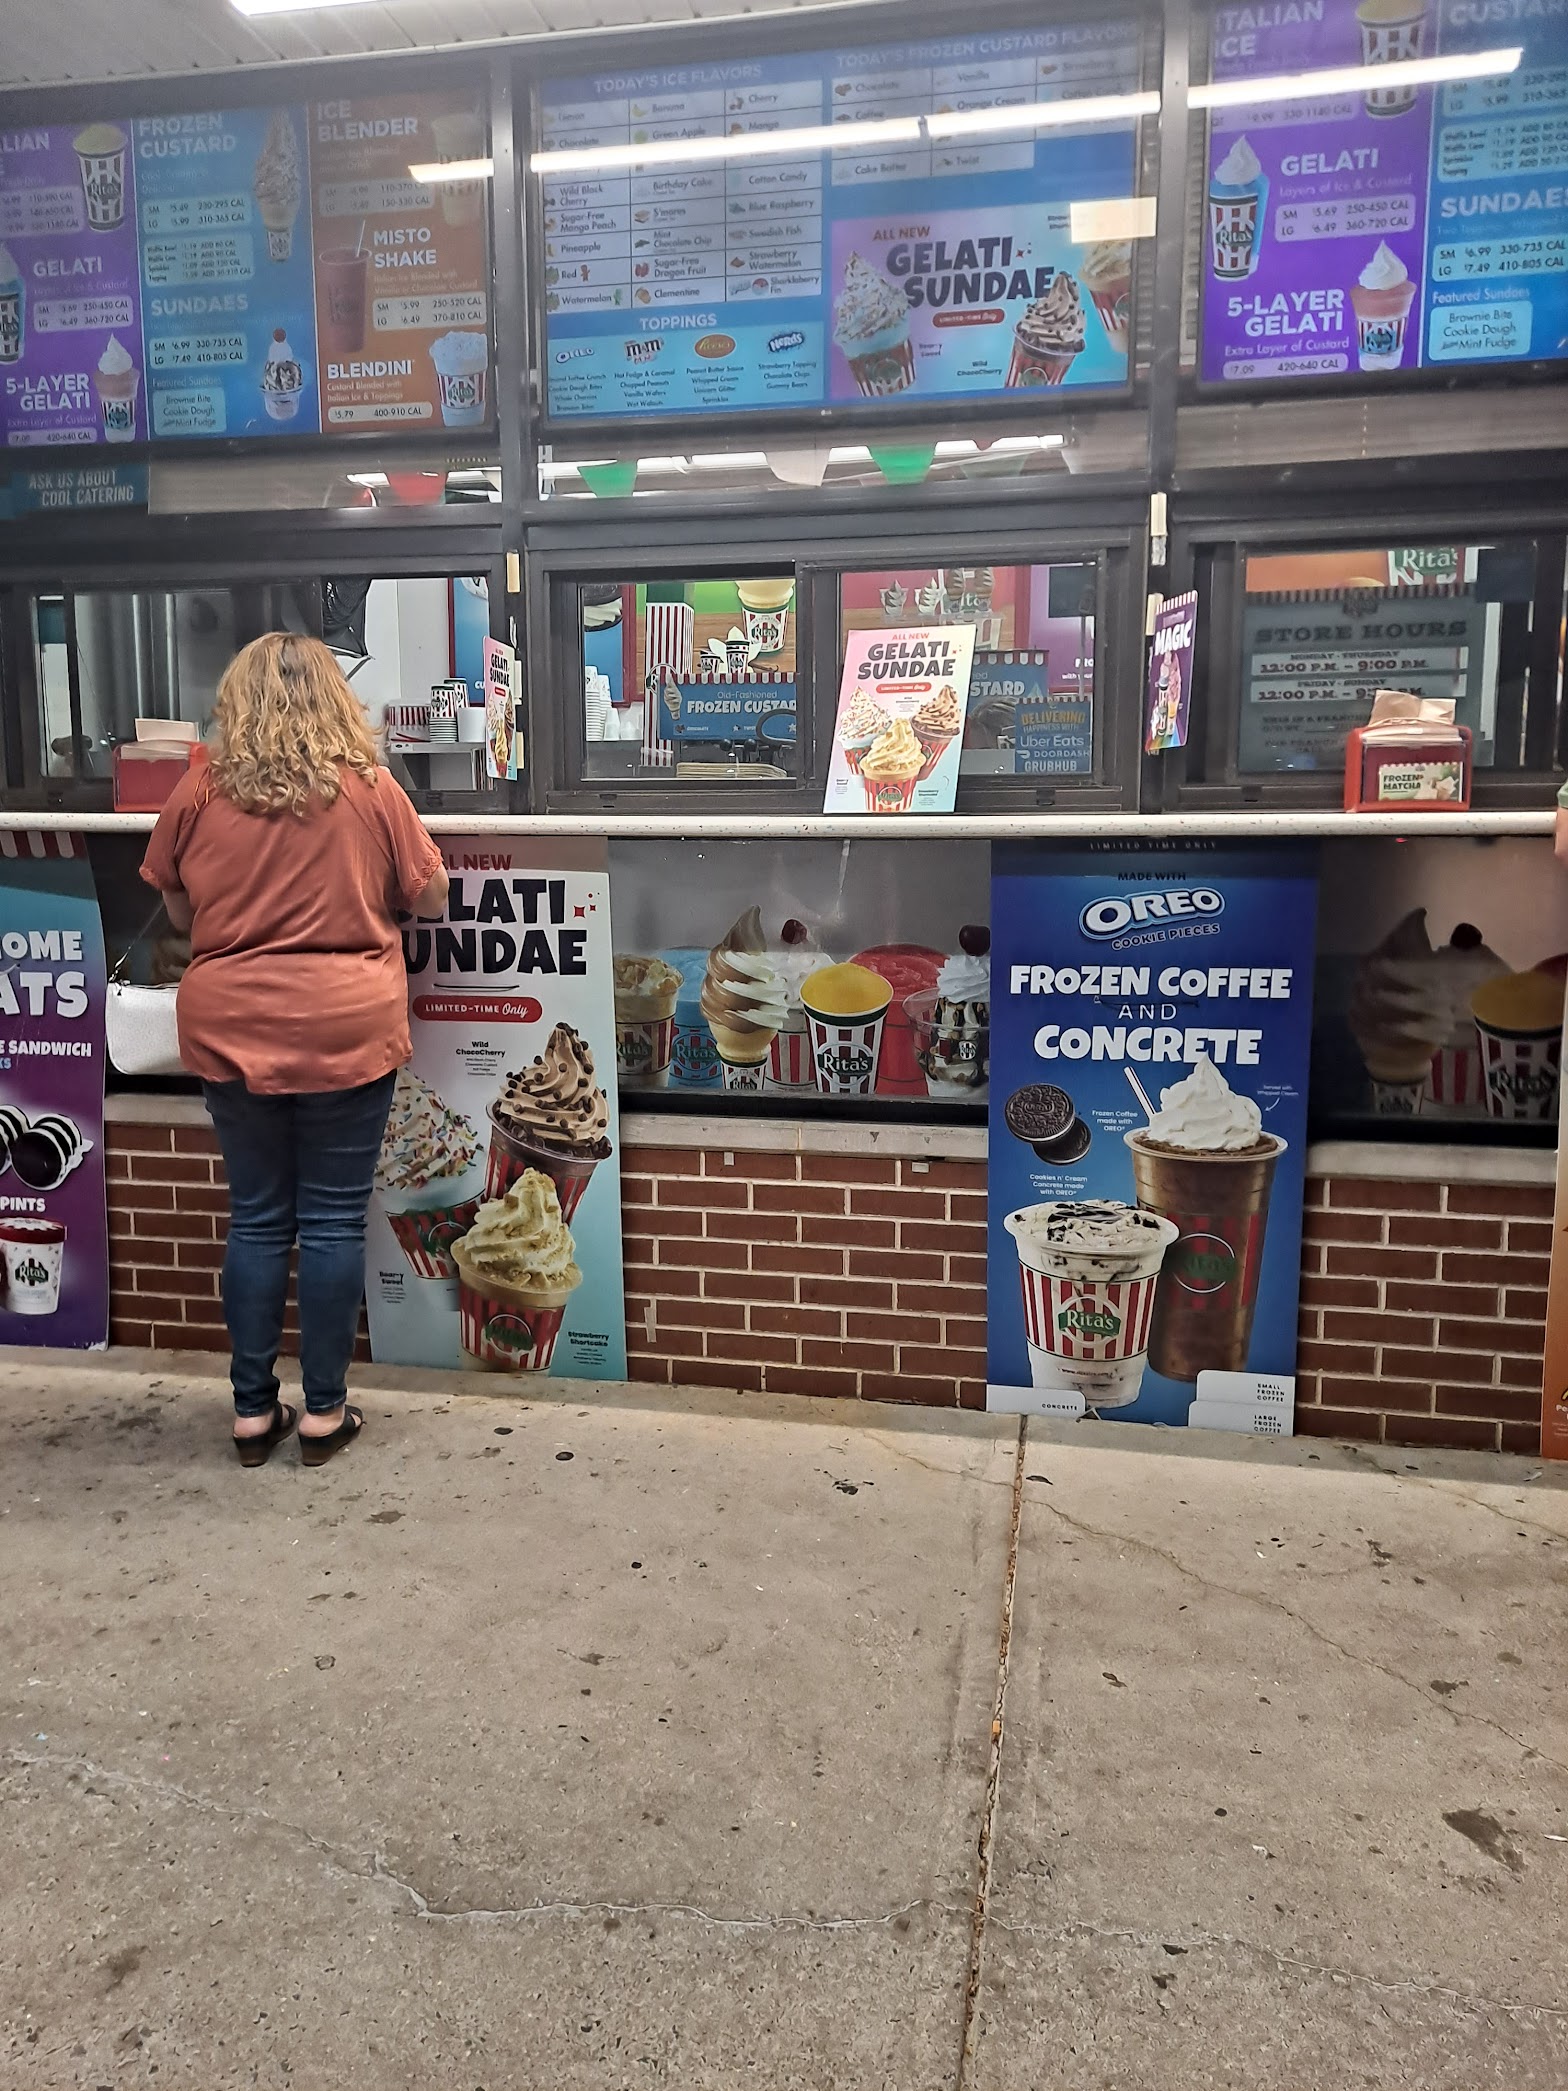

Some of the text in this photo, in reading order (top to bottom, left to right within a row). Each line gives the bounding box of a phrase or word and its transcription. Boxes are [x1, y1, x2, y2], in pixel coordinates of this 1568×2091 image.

[980, 34, 1056, 52] CUSTARD
[1215, 35, 1256, 58] ICE
[663, 72, 688, 84] ICE
[691, 65, 762, 82] FLAVORS
[749, 93, 778, 104] Cherry
[318, 102, 351, 120] ICE
[139, 113, 222, 136] FROZEN
[318, 118, 418, 141] BLENDER
[652, 130, 678, 140] Green
[140, 135, 235, 158] CUSTARD
[1281, 148, 1379, 176] GELATI
[1440, 187, 1568, 218] SUNDAE
[374, 227, 431, 246] MISTO
[872, 226, 930, 242] ALL NEW
[561, 242, 601, 255] Pineapple
[886, 237, 1013, 277] GELATI
[1440, 250, 1455, 259] SM
[33, 256, 103, 277] GELATI
[375, 249, 437, 268] SHAKE
[1439, 267, 1451, 276] LG
[1544, 258, 1563, 267] CAL
[562, 270, 577, 279] Red
[904, 267, 1054, 308] SUNDAE
[1432, 289, 1481, 303] Featured
[151, 294, 248, 316] SUNDAES
[1227, 288, 1345, 317] 5-LAYER
[640, 313, 717, 331] TOPPINGS
[1245, 311, 1343, 337] GELATI
[1449, 313, 1490, 322] Brownie
[1444, 322, 1516, 337] Cookie Dough
[1291, 339, 1303, 351] of
[328, 360, 412, 379] BLENDINI
[6, 373, 89, 394] 5-LAYER
[21, 392, 91, 411] GELATI
[29, 470, 116, 489] ASK US ABOUT
[42, 485, 134, 506] COOL CATERING
[1155, 619, 1192, 656] MAGIC
[1255, 621, 1467, 643] STORE HOURS
[868, 641, 950, 661] GELATI
[1291, 652, 1334, 660] MONDAY
[491, 653, 508, 672] GELATI
[858, 659, 956, 679] SUNDAE
[1261, 664, 1306, 673] 12:00
[1358, 660, 1396, 670] 9:00
[490, 667, 509, 687] SUNDAE
[1259, 690, 1304, 700] 12:00
[687, 701, 740, 713] FROZEN
[1021, 736, 1084, 747] Uber Eats
[1034, 750, 1091, 758] DOORDASH
[1025, 761, 1077, 772] GRUBHUB
[463, 854, 512, 870] NEW
[417, 878, 566, 924] LATI
[1086, 890, 1220, 932] OREO
[0, 930, 82, 961] OME
[1112, 924, 1219, 950] COOKIE PIECES
[402, 928, 587, 975] UNDAE
[1010, 965, 1293, 999] FROZEN COFFEE
[425, 1003, 529, 1018] LIMITED-TIME Only
[1118, 1003, 1177, 1020] AND
[8, 1040, 92, 1057] SANDWICH
[456, 1049, 506, 1058] ChocoCherry
[471, 1040, 489, 1048] Wild
[1033, 1024, 1263, 1065] CONCRETE
[824, 1053, 868, 1072] Rita's
[0, 1196, 45, 1212] PINTS
[20, 1266, 45, 1278] Rita's
[1067, 1310, 1114, 1329] Rita's
